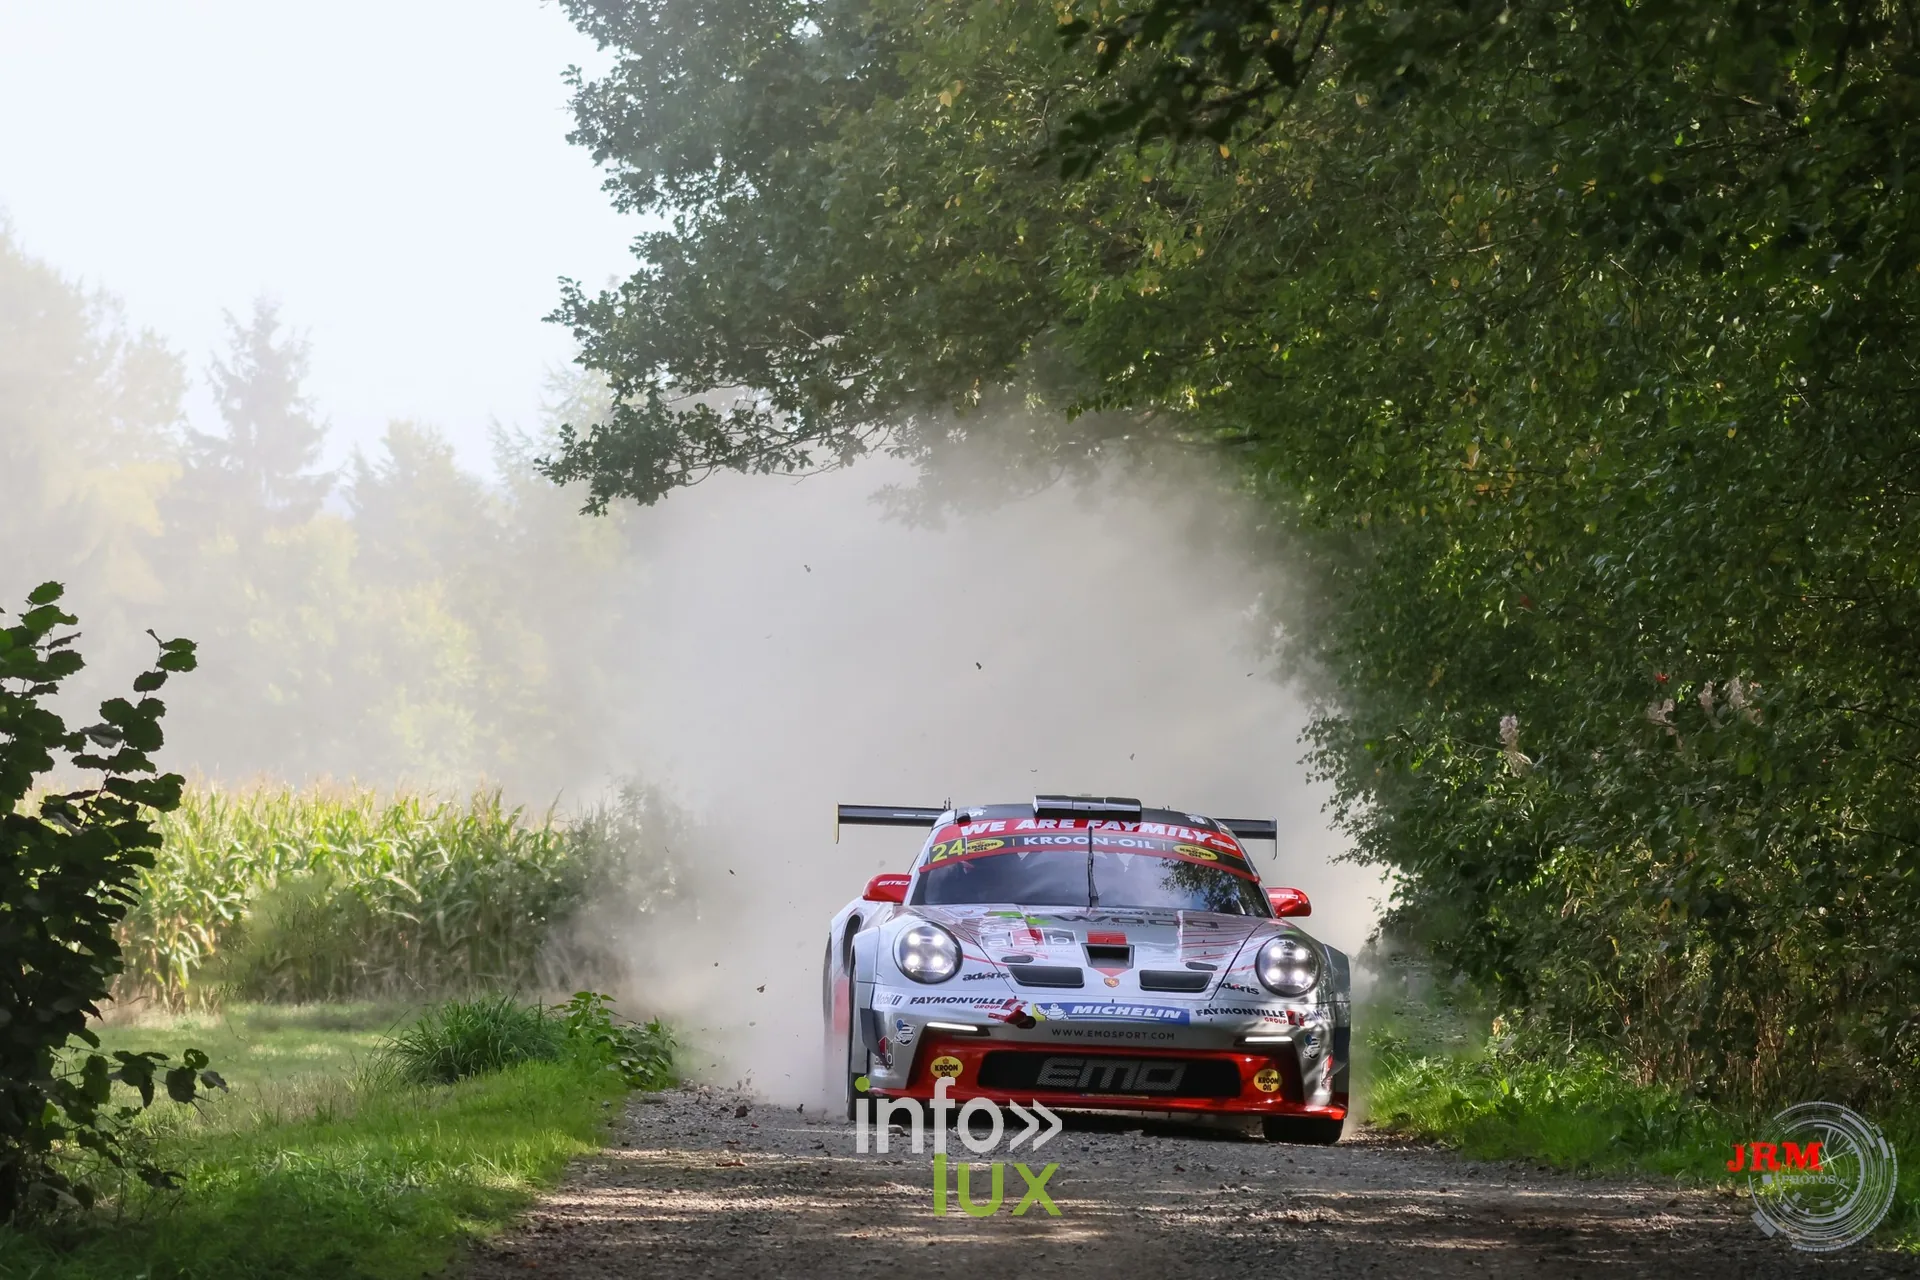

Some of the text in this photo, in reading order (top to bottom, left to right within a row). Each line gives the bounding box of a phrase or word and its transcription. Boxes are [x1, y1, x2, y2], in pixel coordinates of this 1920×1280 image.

[961, 819, 1213, 842] WE ARE FAYMILY
[1023, 836, 1155, 849] KROON-OIL
[932, 839, 965, 862] 24
[909, 996, 1006, 1005] FAYMONVILLE
[1071, 1005, 1182, 1019] MICHELIN
[1196, 1008, 1286, 1018] FAYMONVILLE
[1264, 1017, 1288, 1025] GROUP
[1051, 1028, 1175, 1040] WWW.EMOSPORT.COM
[935, 1064, 959, 1072] KROON
[1258, 1076, 1279, 1084] KROON
